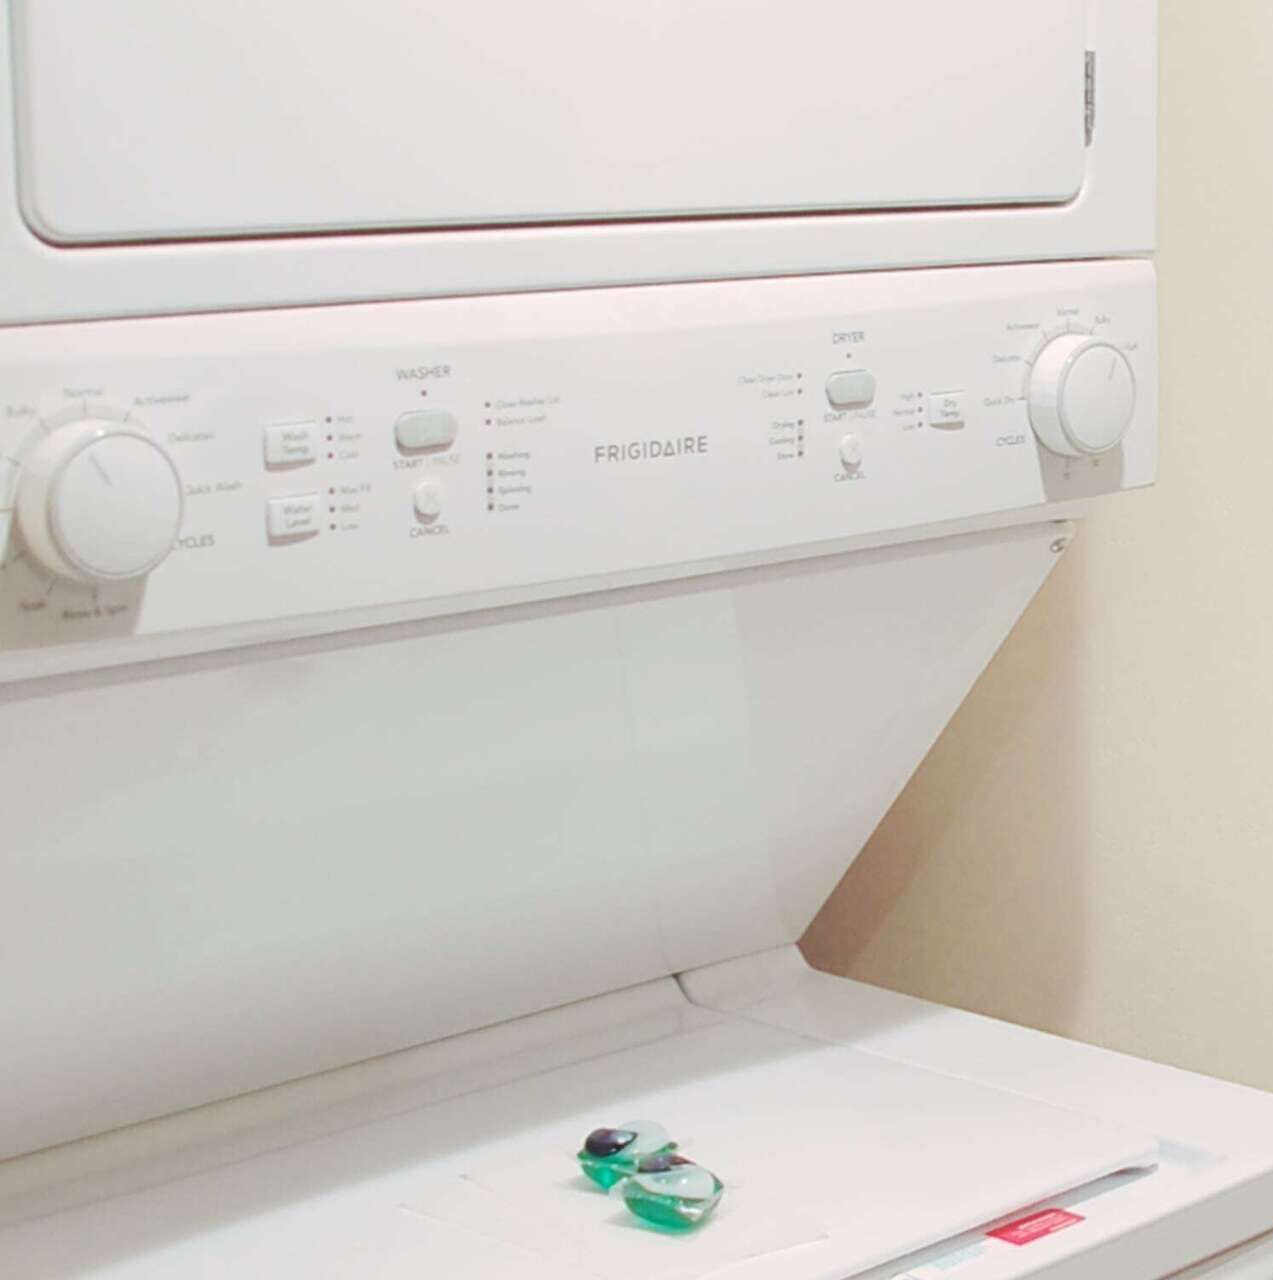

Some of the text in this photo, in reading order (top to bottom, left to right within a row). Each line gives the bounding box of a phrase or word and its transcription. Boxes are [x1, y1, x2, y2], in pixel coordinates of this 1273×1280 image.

[832, 330, 866, 344] DRYER
[396, 365, 452, 381] WASHER
[593, 434, 708, 464] FRIGIDAIRE
[392, 457, 424, 471] START
[408, 523, 450, 540] CANCEL
[176, 533, 216, 551] YCLES
